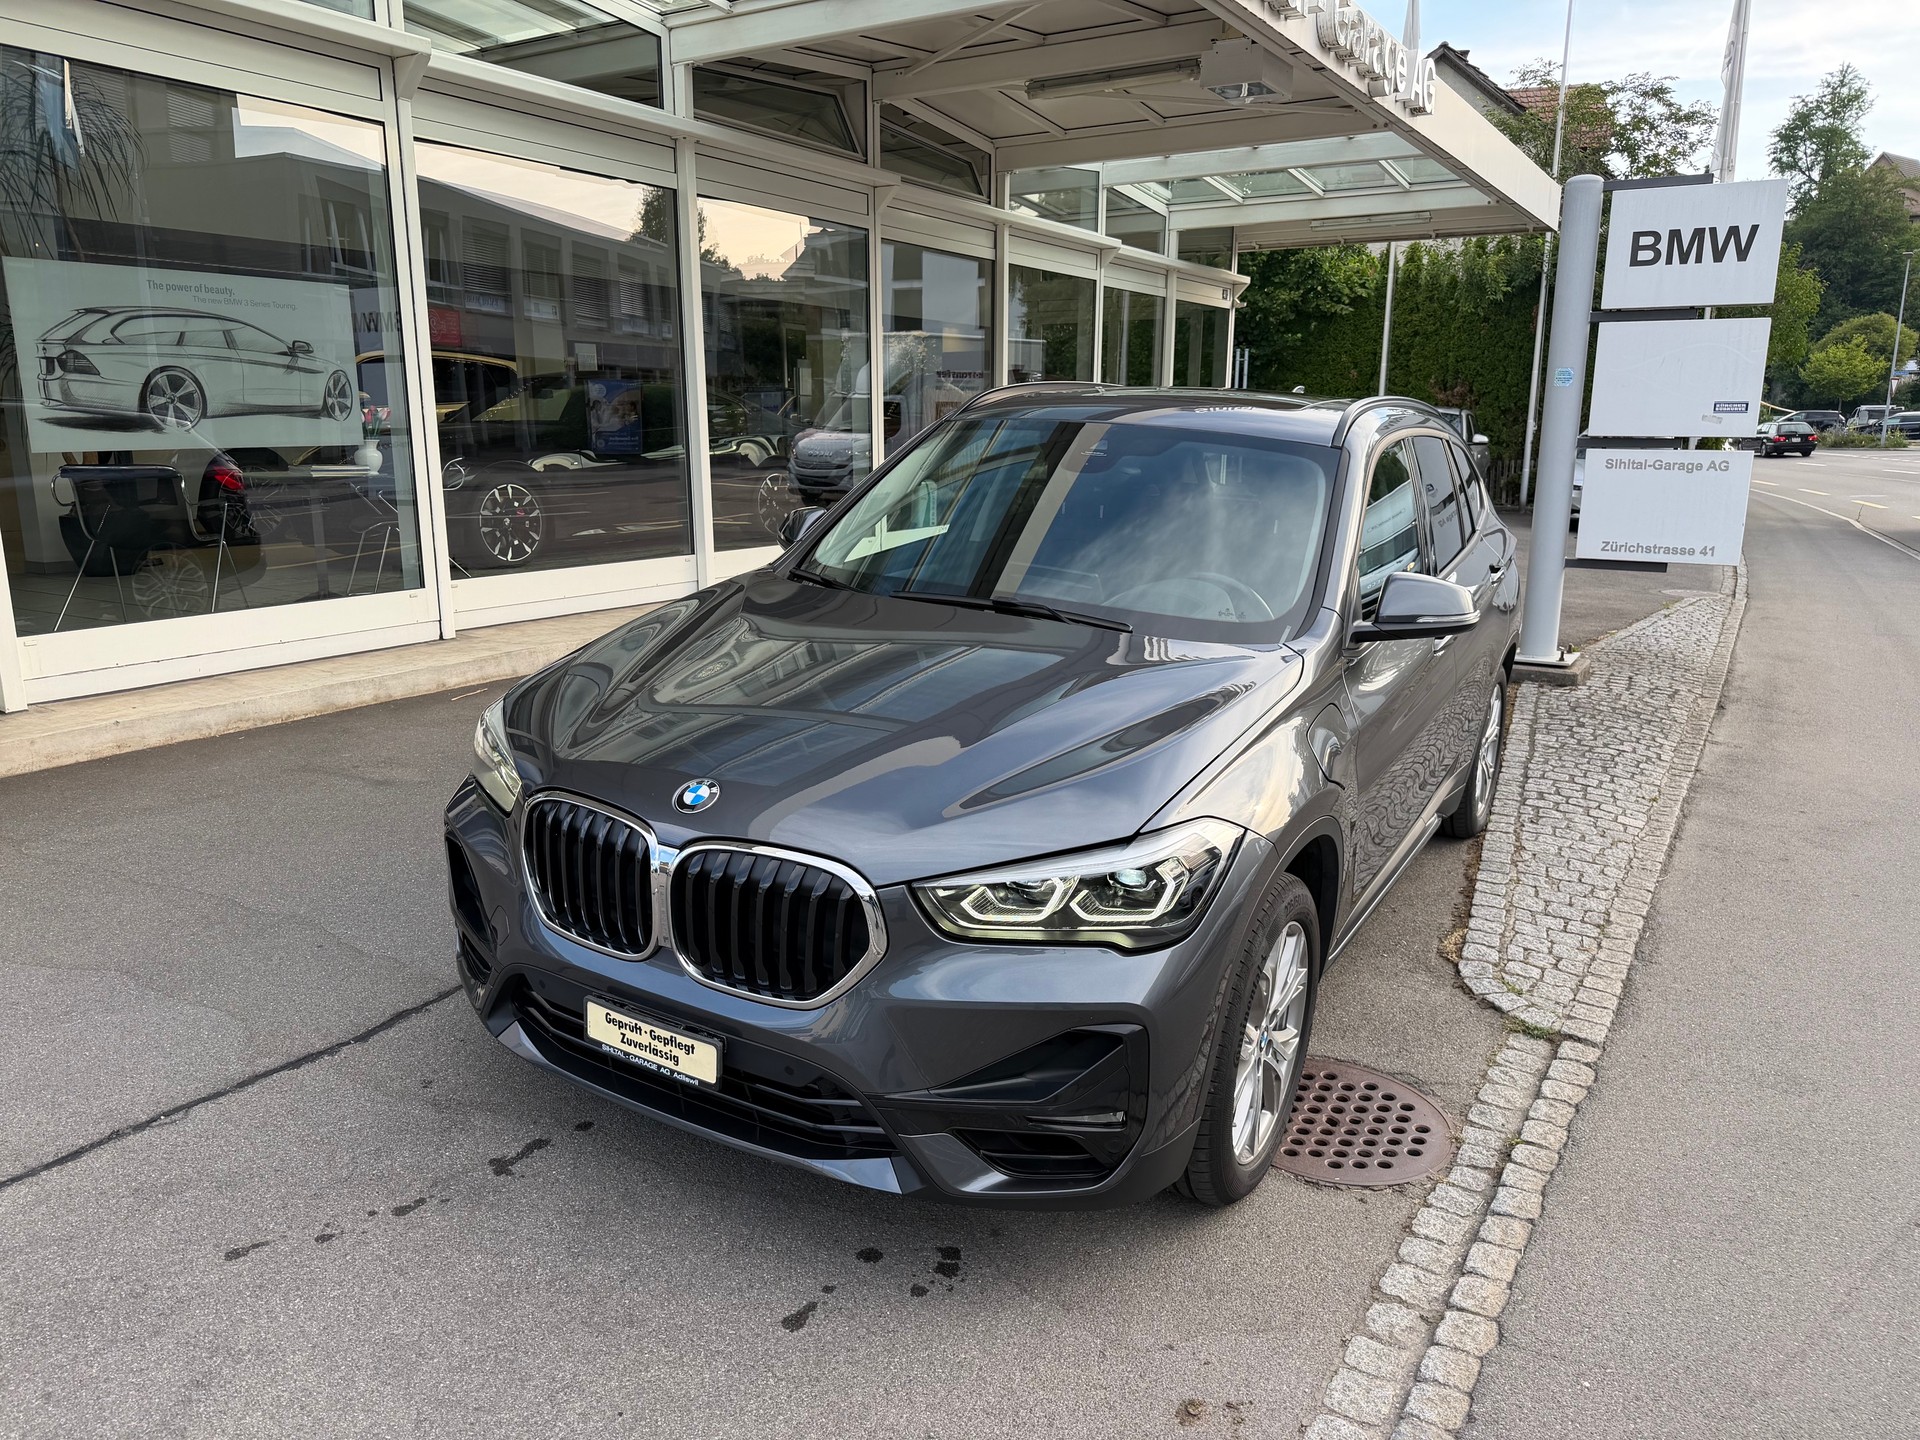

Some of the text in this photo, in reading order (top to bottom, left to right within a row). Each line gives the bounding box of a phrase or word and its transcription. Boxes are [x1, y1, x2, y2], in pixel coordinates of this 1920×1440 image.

[1410, 50, 1436, 115] AG
[1629, 223, 1760, 267] BMW
[146, 279, 235, 298] The power of beauty.
[193, 295, 207, 304] The
[223, 297, 243, 306] BMW
[244, 298, 250, 307] 3
[250, 299, 271, 309] Series
[272, 301, 299, 312] Touring.
[1605, 458, 1730, 474] Sihltal-Garage AG
[1600, 541, 1716, 557] Zürichstrasse 41
[605, 1012, 696, 1055] Geprüft Gepflegt
[620, 1032, 680, 1066] Zuverlässig
[659, 1066, 671, 1076] AG
